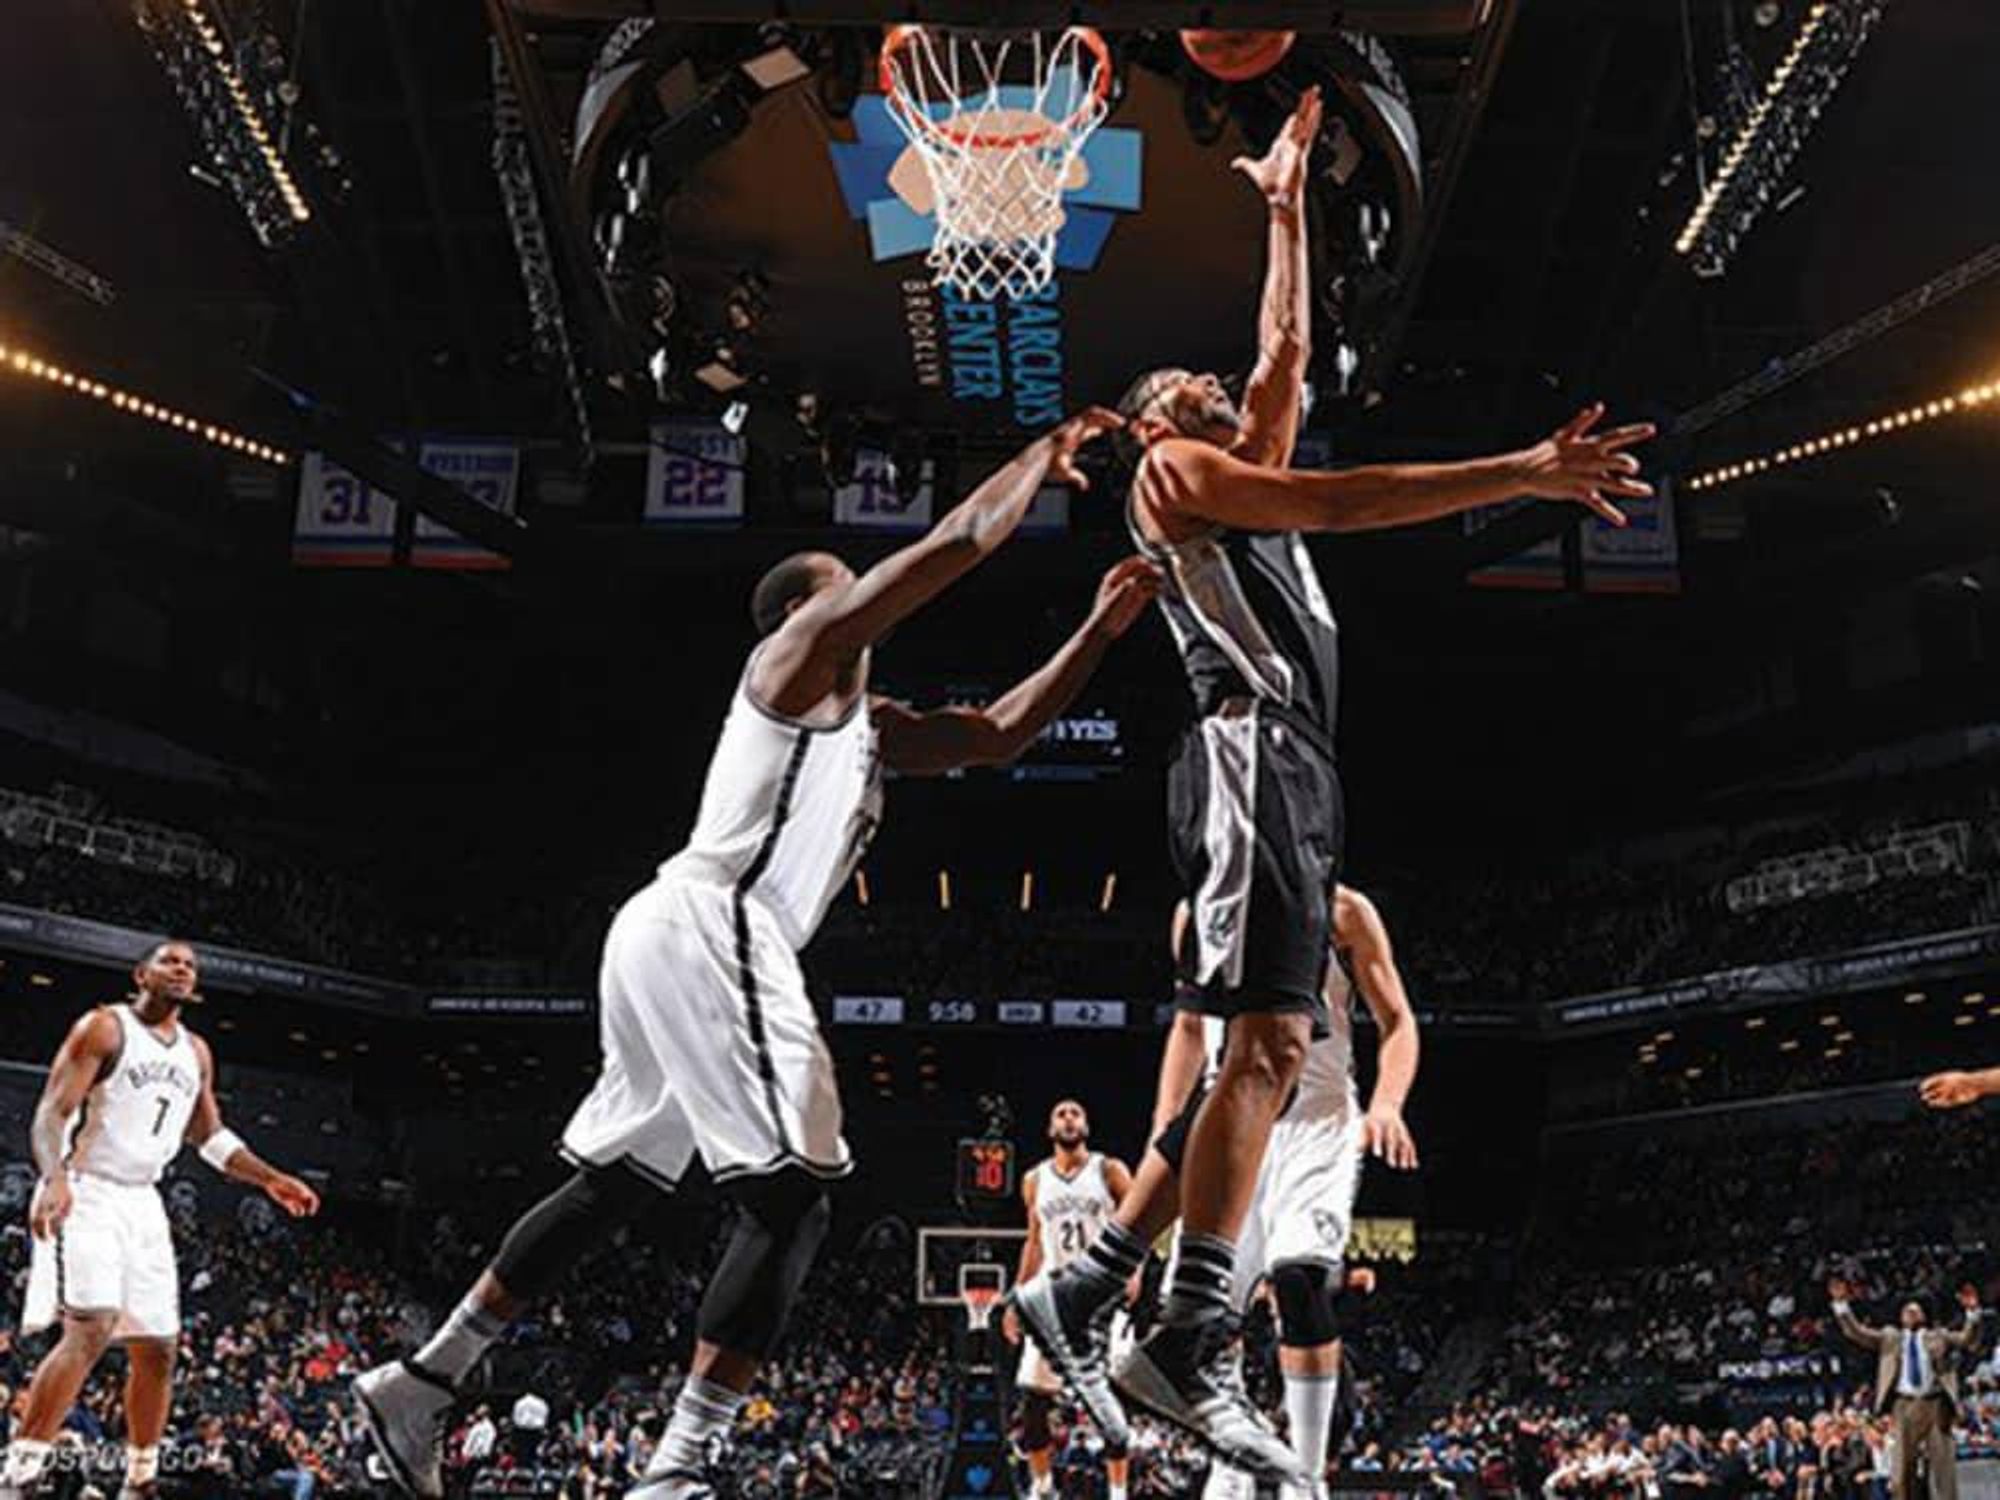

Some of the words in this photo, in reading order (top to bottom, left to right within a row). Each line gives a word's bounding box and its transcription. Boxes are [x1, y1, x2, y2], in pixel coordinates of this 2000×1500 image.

[320, 478, 369, 524] 31
[664, 460, 727, 507] 22
[1069, 709, 1117, 741] YES
[855, 1001, 884, 1018] 47
[152, 1095, 170, 1136] 7
[1060, 1220, 1087, 1251] 21
